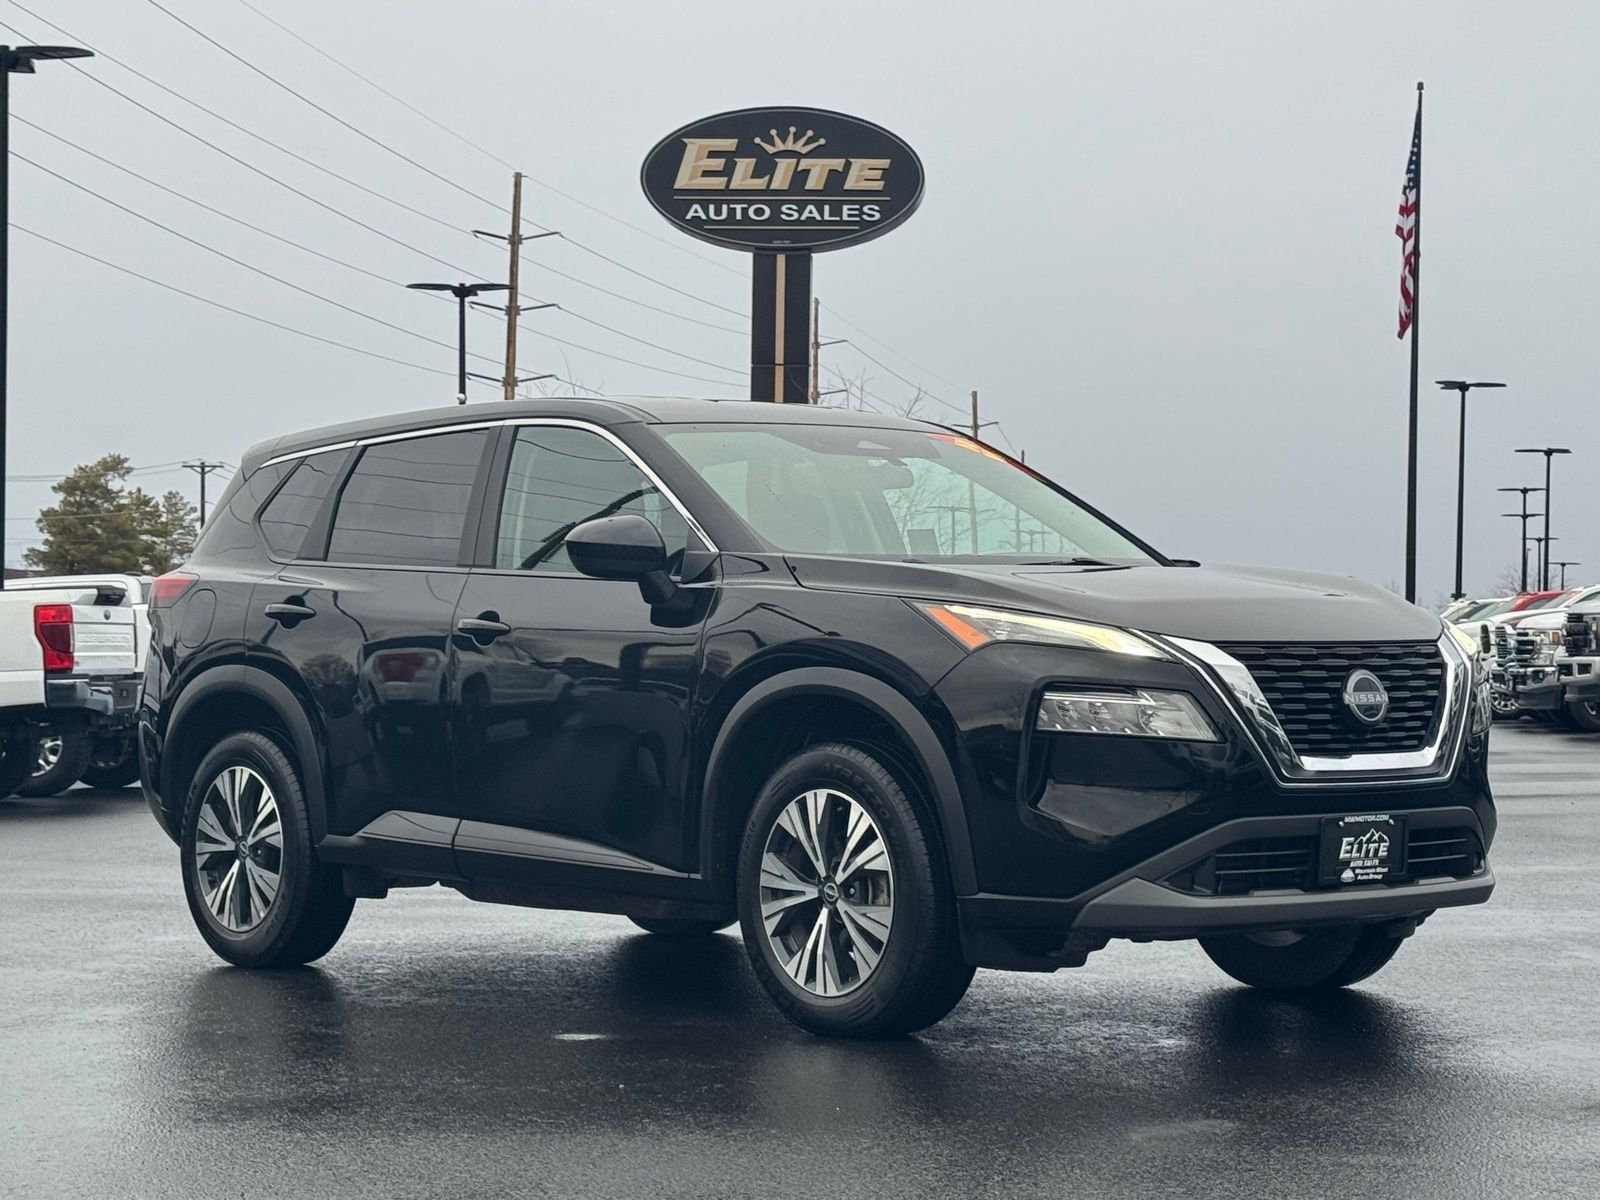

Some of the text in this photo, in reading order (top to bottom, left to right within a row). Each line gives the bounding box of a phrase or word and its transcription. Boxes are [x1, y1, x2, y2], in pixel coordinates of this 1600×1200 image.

[685, 204, 881, 221] AUTO SALES
[1345, 694, 1388, 703] NISSAN
